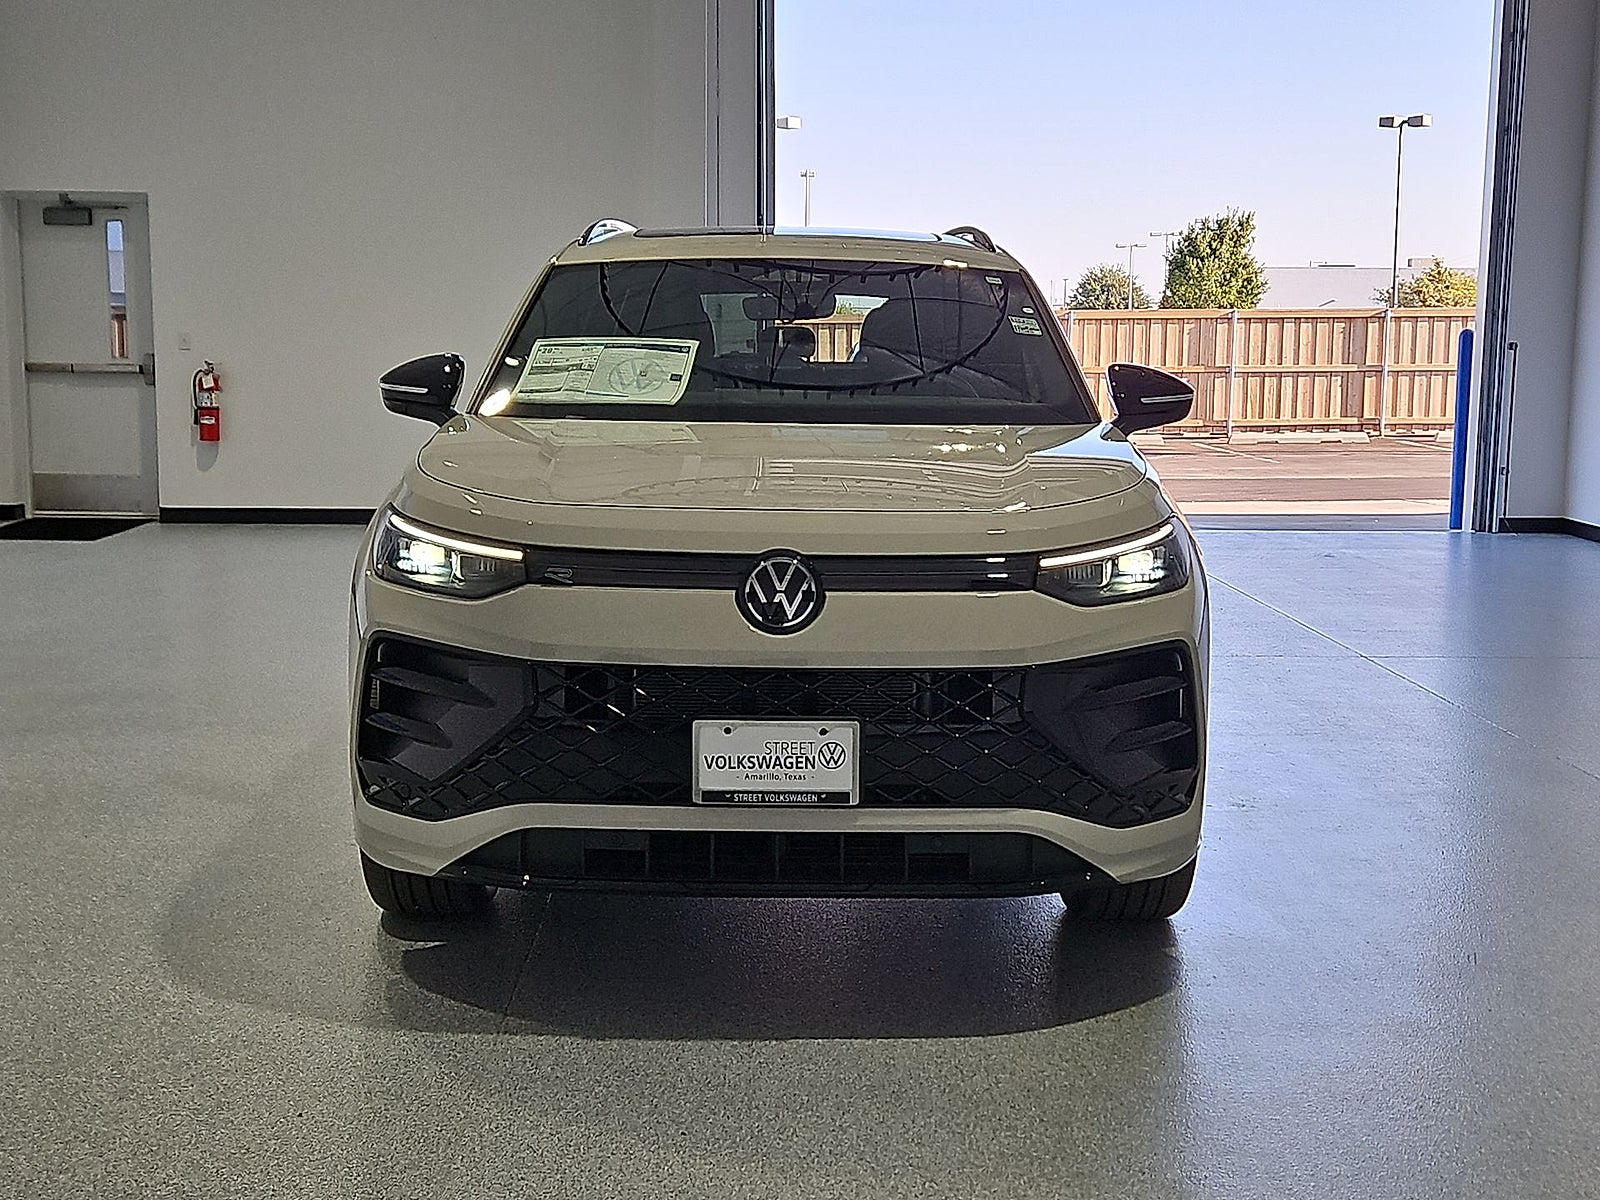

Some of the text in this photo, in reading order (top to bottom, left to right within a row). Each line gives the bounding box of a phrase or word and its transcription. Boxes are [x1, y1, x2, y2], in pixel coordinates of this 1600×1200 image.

[745, 556, 817, 627] VW
[764, 741, 816, 755] STREET
[704, 755, 816, 770] VOLKSWAGEN
[818, 741, 846, 770] VW
[744, 772, 807, 781] Amarillo, Texas
[733, 793, 818, 802] STREET VOLKSWAGEN
